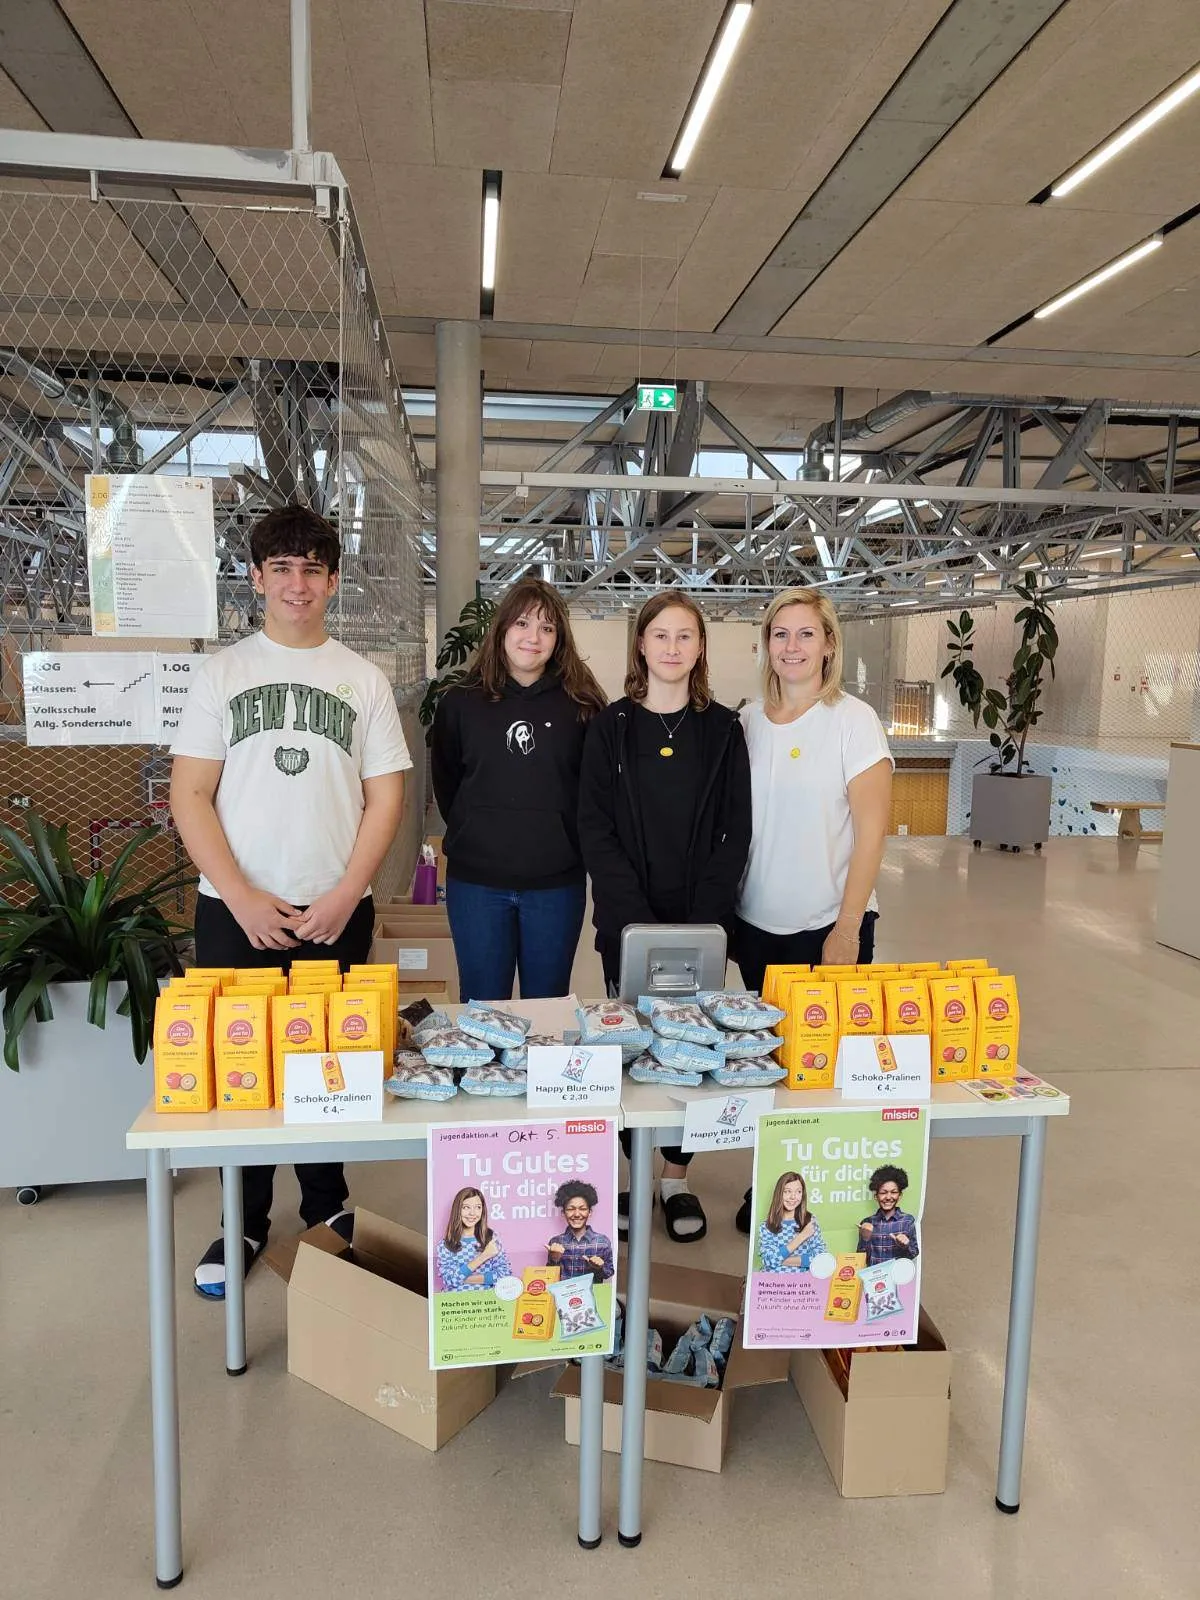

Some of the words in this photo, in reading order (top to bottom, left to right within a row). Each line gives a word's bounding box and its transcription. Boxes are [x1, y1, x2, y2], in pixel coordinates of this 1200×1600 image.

[162, 664, 190, 672] 1.OG
[33, 706, 96, 714] Volksschule
[34, 720, 59, 730] Allg.
[62, 719, 132, 728] Sonderschule
[229, 682, 290, 748] NEW
[290, 683, 358, 758] YORK
[852, 1074, 921, 1082] Schoko-Pralinen
[535, 1085, 564, 1094] Happy
[589, 1084, 615, 1092] Chips
[294, 1094, 372, 1104] Schoko-Pralinen
[323, 1106, 328, 1114] €
[883, 1110, 918, 1120] missio
[568, 1122, 606, 1133] missio
[766, 1118, 820, 1126] jugendaktion.at
[440, 1132, 498, 1142] jugendaktion.at
[508, 1130, 538, 1143] Okt.
[780, 1138, 812, 1162] Tu
[822, 1136, 903, 1160] Gutes
[456, 1153, 492, 1176] Tu
[502, 1150, 590, 1174] Gutes
[802, 1165, 829, 1182] für
[835, 1164, 874, 1182] dich
[480, 1180, 510, 1198] für
[517, 1176, 559, 1196] dich
[810, 1188, 824, 1204] &
[830, 1184, 872, 1202] mich
[490, 1203, 506, 1220] &
[512, 1200, 559, 1219] mich
